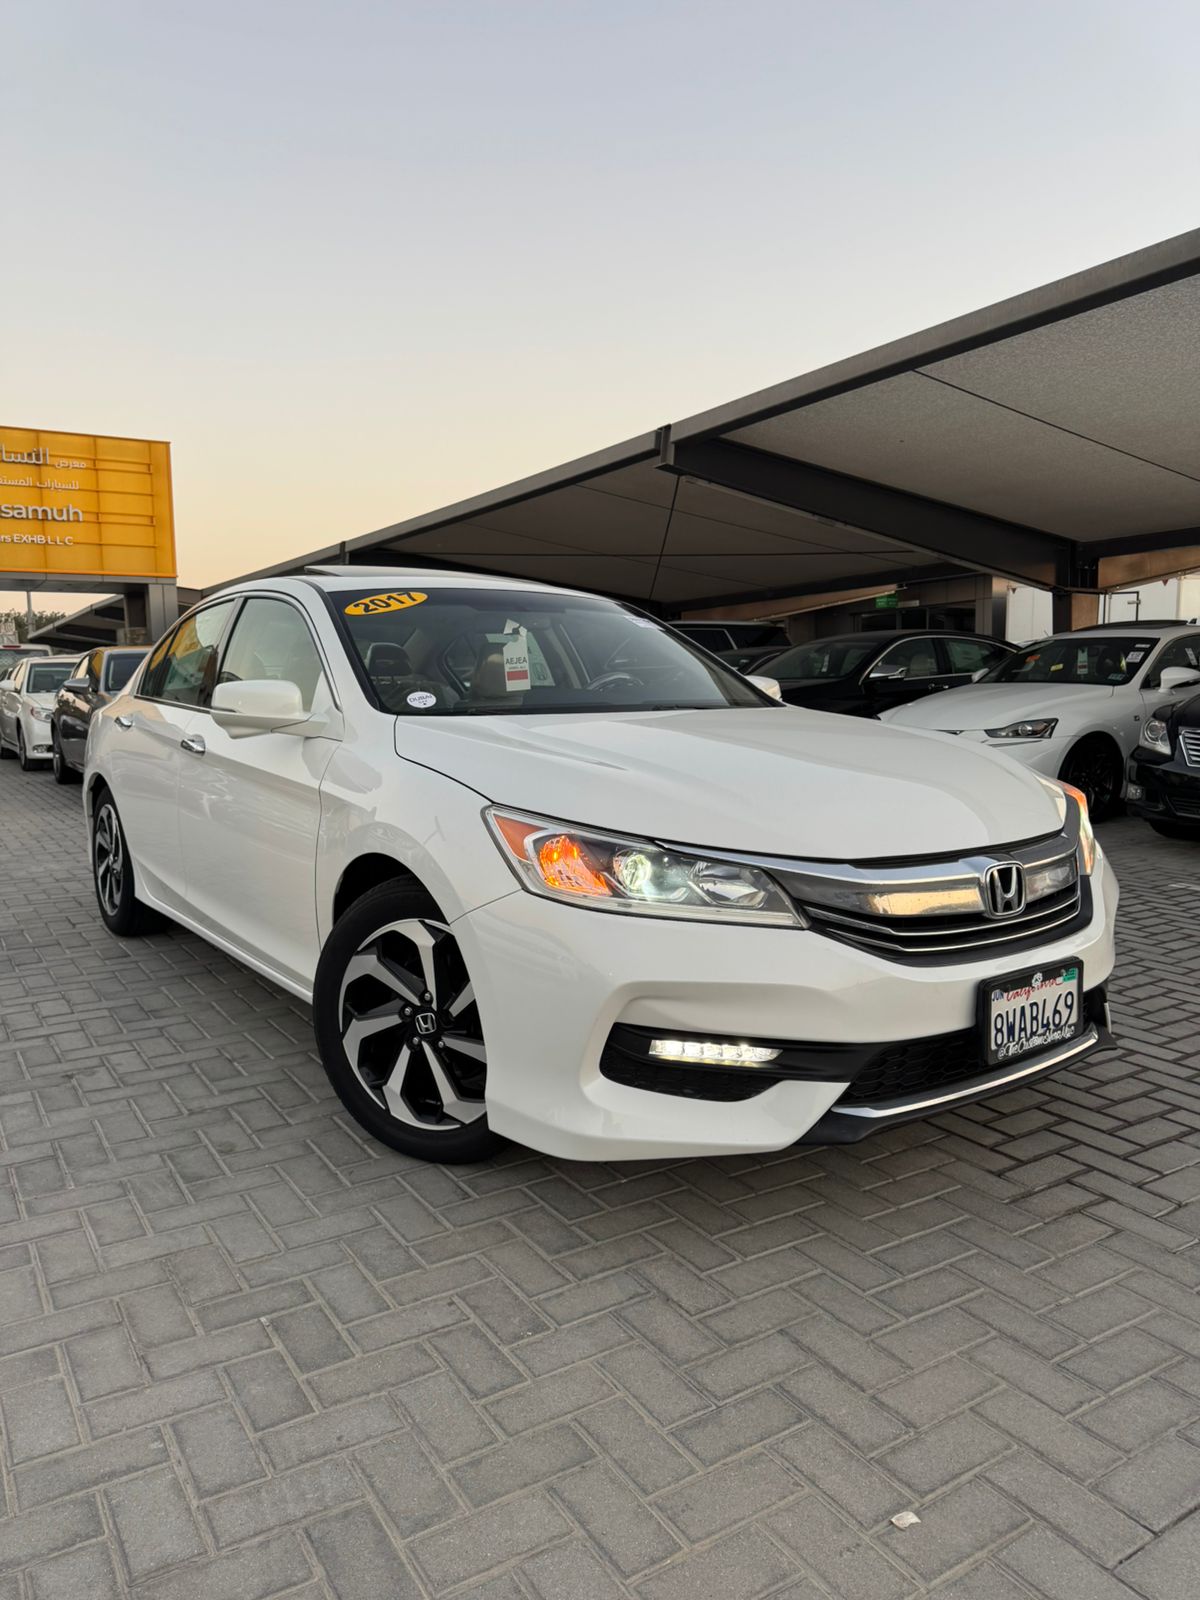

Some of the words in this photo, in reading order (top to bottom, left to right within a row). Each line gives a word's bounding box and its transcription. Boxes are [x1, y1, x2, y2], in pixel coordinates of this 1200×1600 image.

[0, 503, 83, 522] samuh
[13, 533, 46, 545] EXHB
[352, 591, 418, 613] 2017
[993, 990, 1075, 1048] 8WAB469
